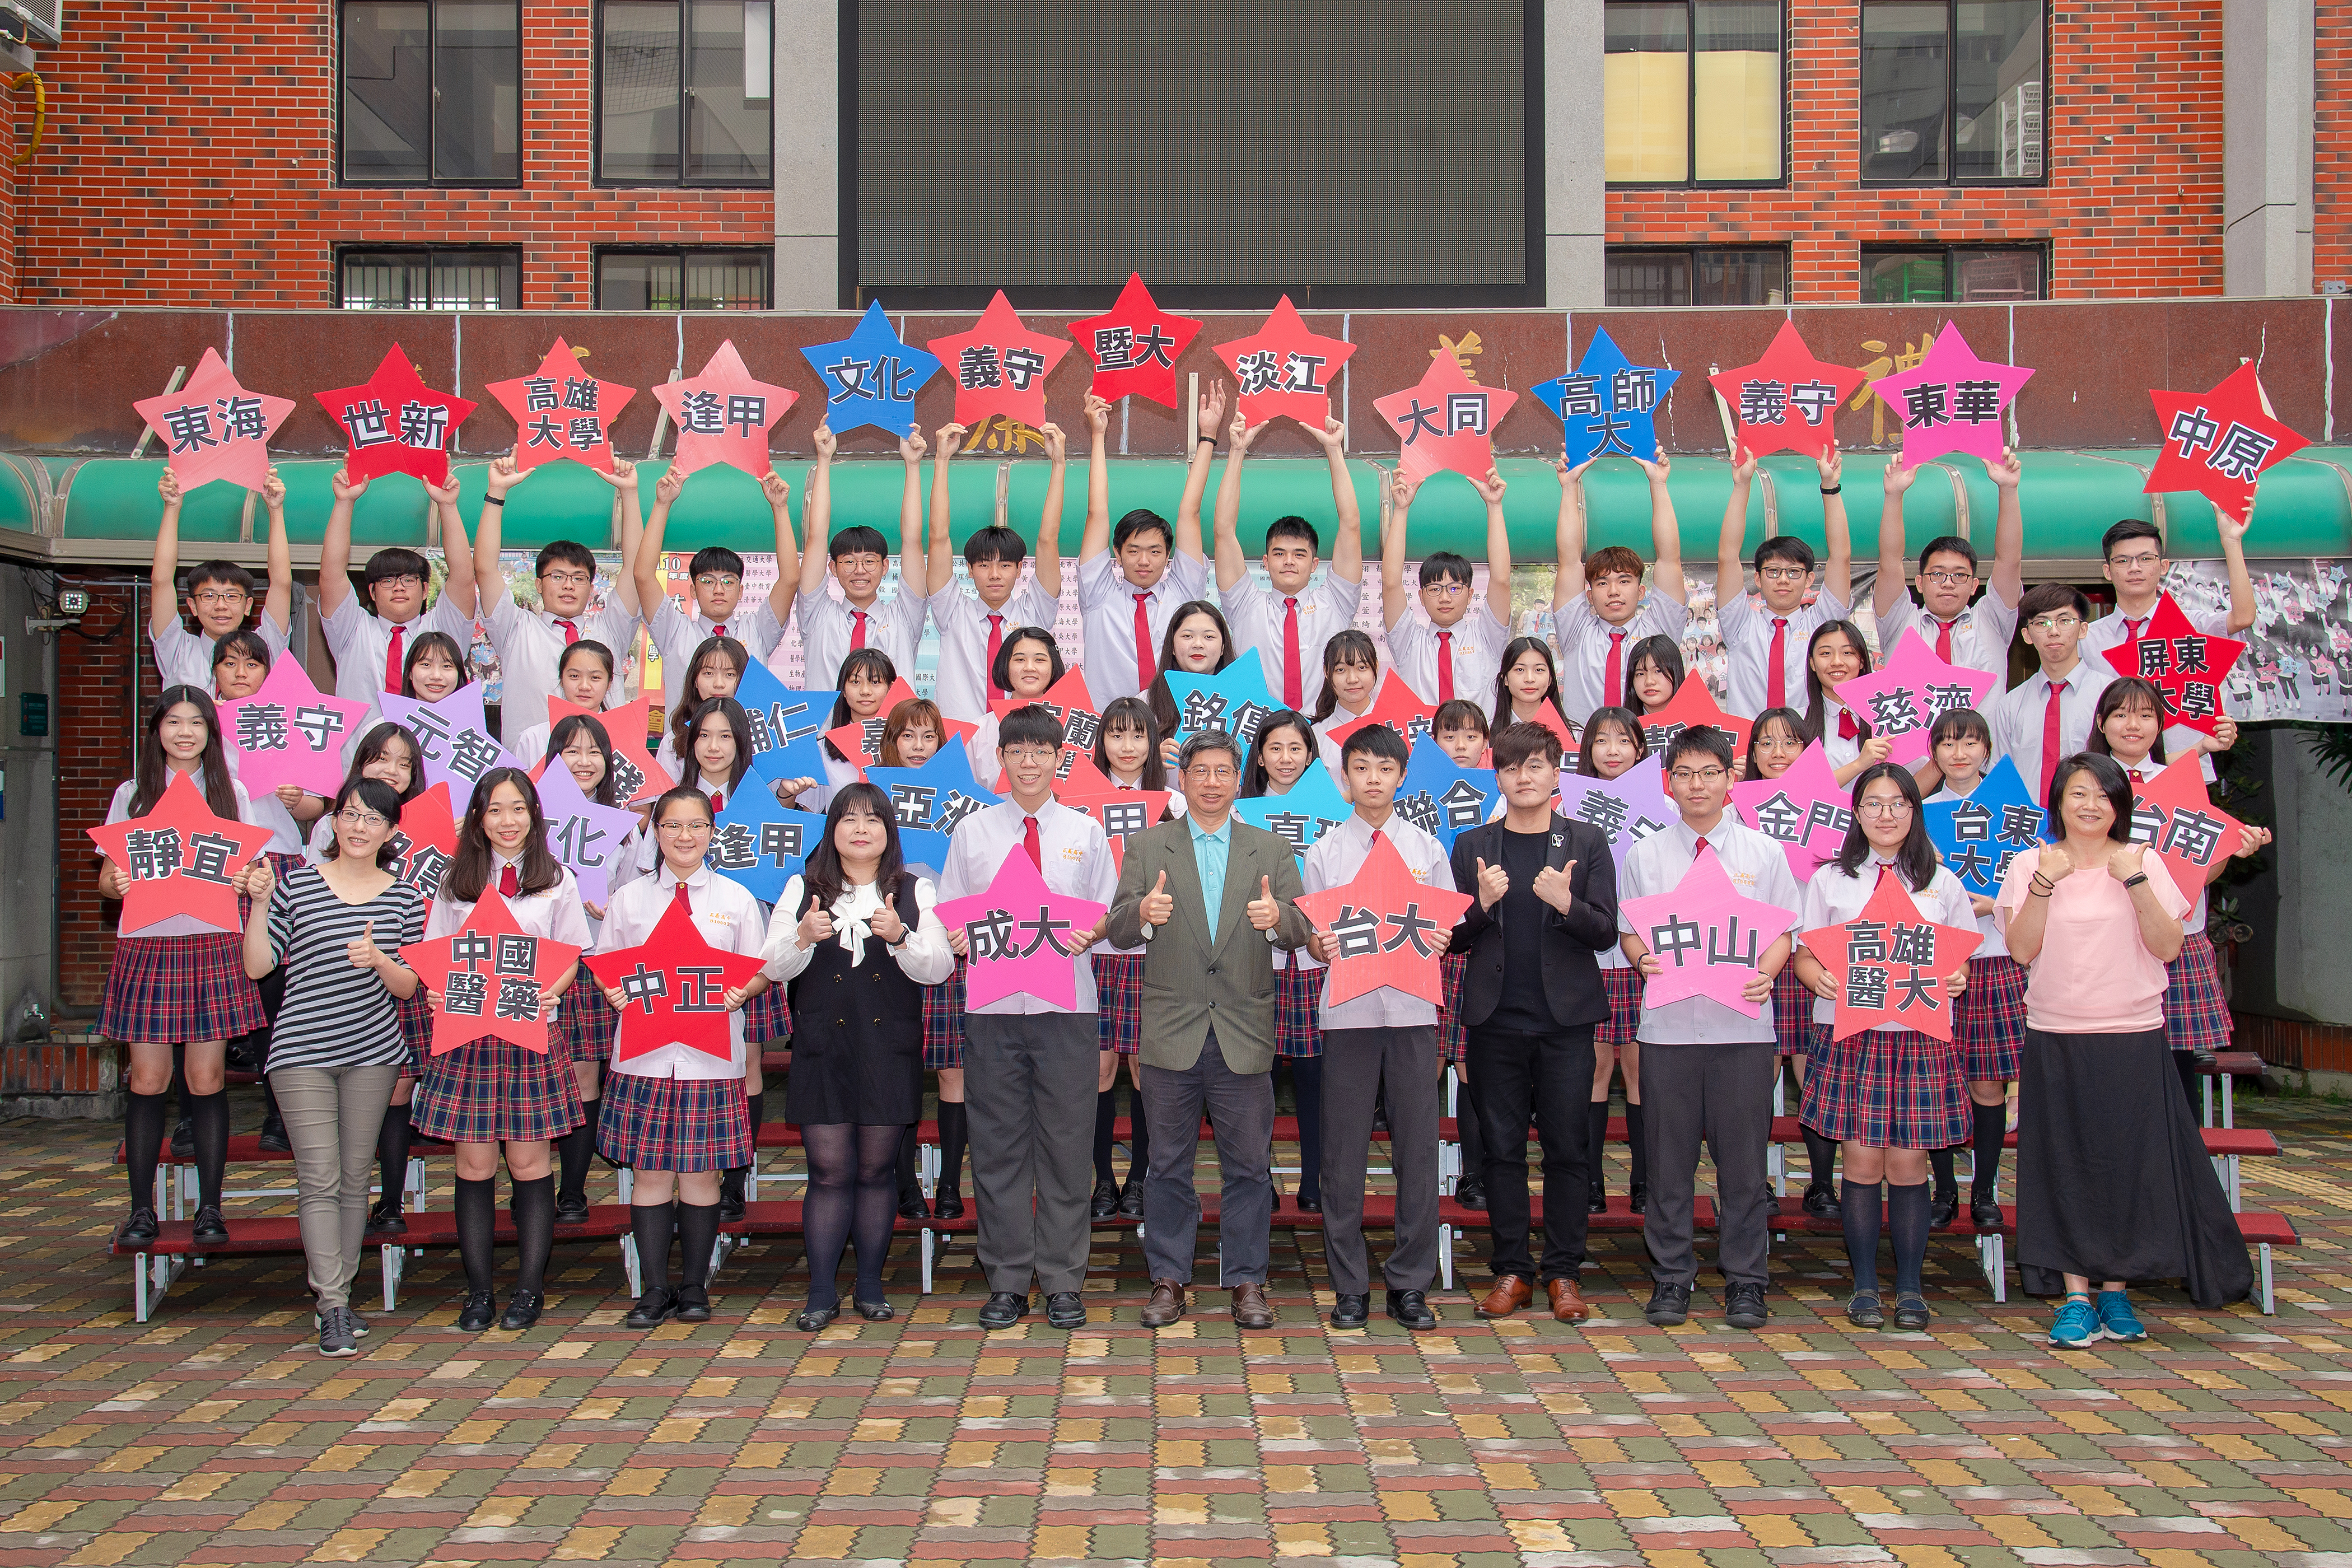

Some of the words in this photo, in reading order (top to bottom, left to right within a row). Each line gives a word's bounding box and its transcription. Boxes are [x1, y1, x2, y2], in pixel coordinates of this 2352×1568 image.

[958, 344, 1046, 391] 義守
[1094, 325, 1175, 372] 暨大
[1235, 349, 1327, 395] 淡江
[523, 376, 599, 413] 高雄
[826, 354, 916, 405] 文化
[1557, 369, 1656, 420] 高師
[1739, 379, 1837, 425] 義守
[162, 395, 269, 456] 東海
[342, 399, 448, 450] 世新
[680, 390, 767, 438] 逢甲
[1397, 393, 1488, 446] 大同
[1902, 380, 2001, 429] 東華
[527, 414, 604, 452] 大學
[1586, 411, 1633, 458] 大
[2168, 405, 2278, 484] 中原
[668, 572, 689, 581] 年度
[1404, 565, 1412, 573] 學
[916, 673, 935, 682] 國際大
[2137, 635, 2210, 677] 屏東
[1181, 689, 1273, 744] 銘傳
[1868, 683, 1972, 739] 慈濟
[2154, 679, 2216, 720] 大學
[236, 703, 344, 752] 義守
[406, 706, 503, 783] 元智
[892, 783, 990, 837] 亞洲
[1393, 779, 1487, 836] 聯合
[1754, 789, 1851, 858] 金門
[1951, 800, 2043, 848] 台東
[2130, 794, 2226, 867] 台南
[126, 827, 242, 885] 靜宜
[709, 822, 802, 871] 逢甲
[451, 930, 538, 976] 中國
[965, 905, 1071, 967] 成大
[1329, 902, 1437, 960] 台大
[1650, 913, 1758, 969] 中山
[1844, 920, 1935, 967] 高雄
[445, 972, 543, 1022] 醫藥
[620, 963, 727, 1014] 中正
[1846, 965, 1940, 1013] 醫大
